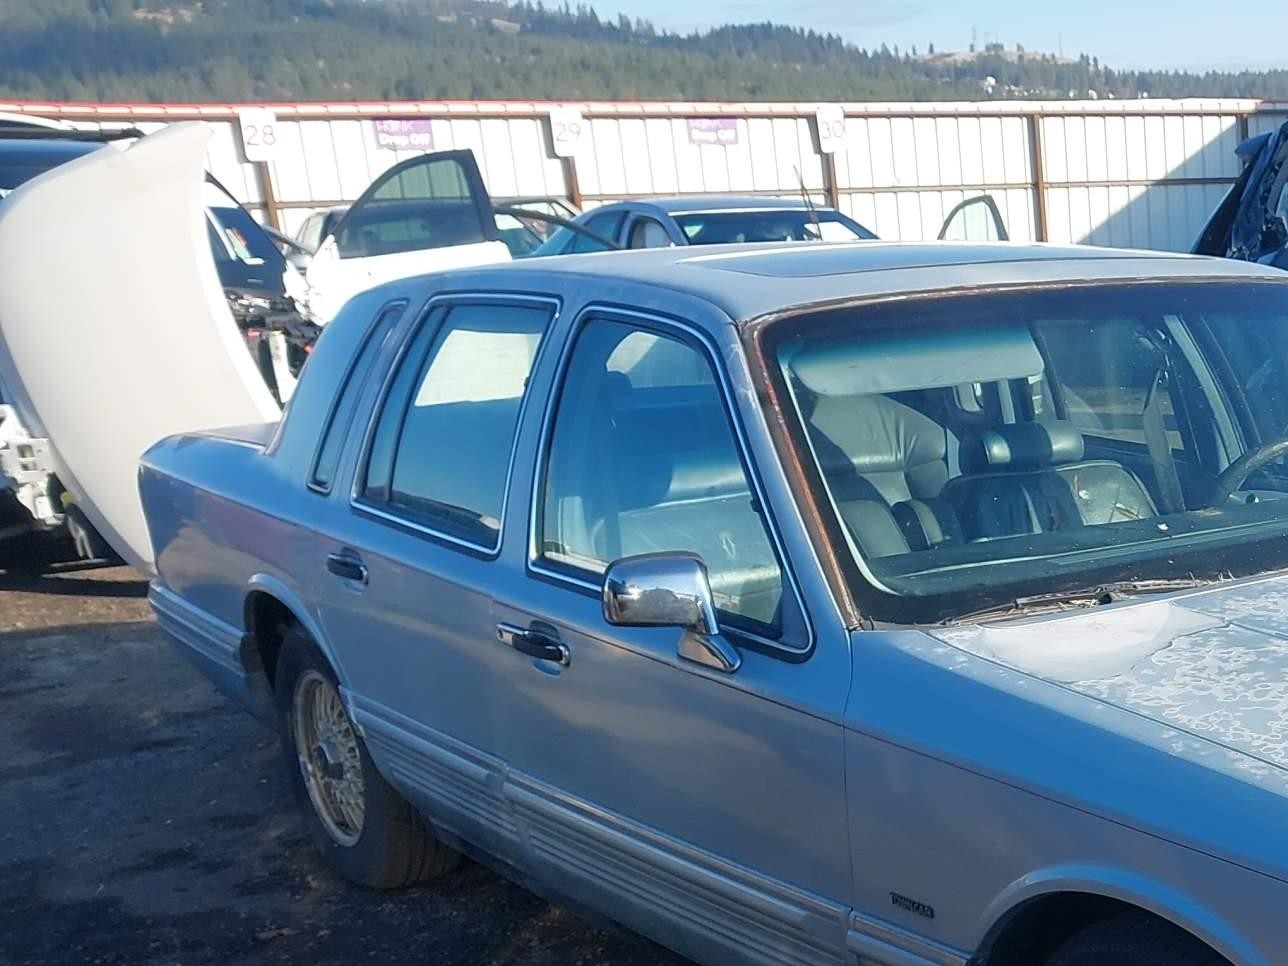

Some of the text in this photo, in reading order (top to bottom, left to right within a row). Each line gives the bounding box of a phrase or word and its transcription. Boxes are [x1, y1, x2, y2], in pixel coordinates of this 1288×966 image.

[244, 125, 276, 146] 28
[554, 122, 581, 142] 29
[822, 120, 844, 139] 30
[379, 133, 430, 147] Drop Off
